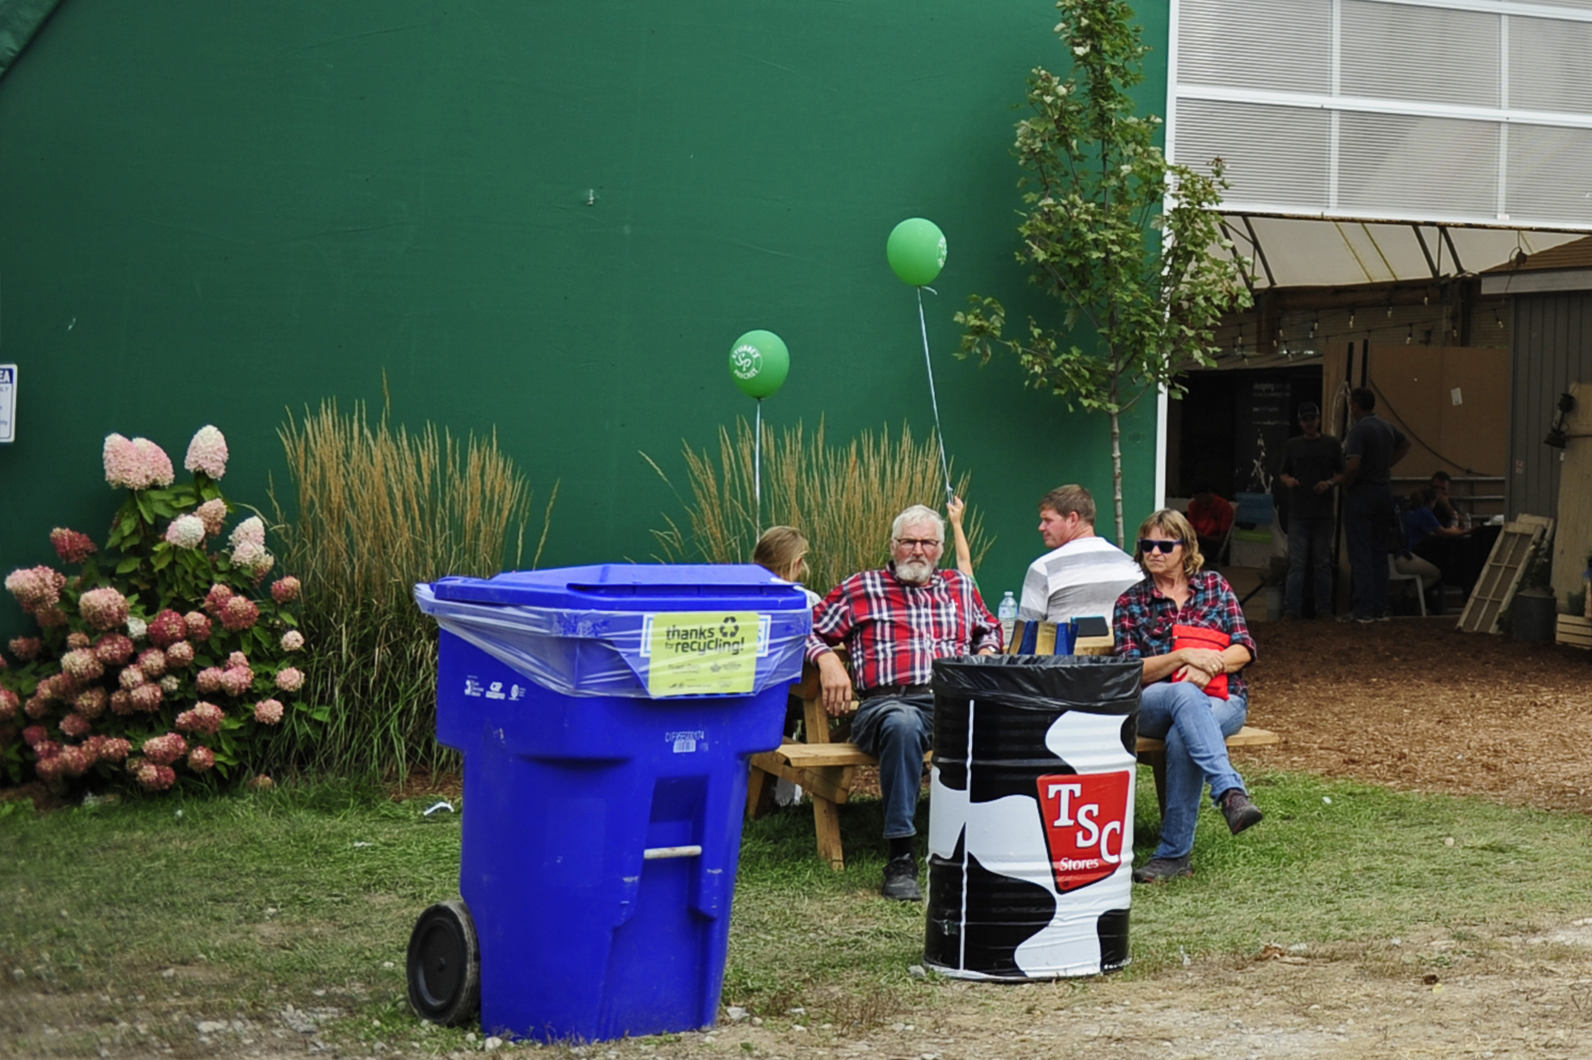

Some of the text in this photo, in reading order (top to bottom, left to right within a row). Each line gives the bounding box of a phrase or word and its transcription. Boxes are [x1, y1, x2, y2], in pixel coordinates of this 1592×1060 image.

[665, 624, 715, 640] thanks
[665, 637, 744, 656] for recycling!
[1047, 783, 1121, 864] TSC
[1060, 857, 1100, 871] Stores
